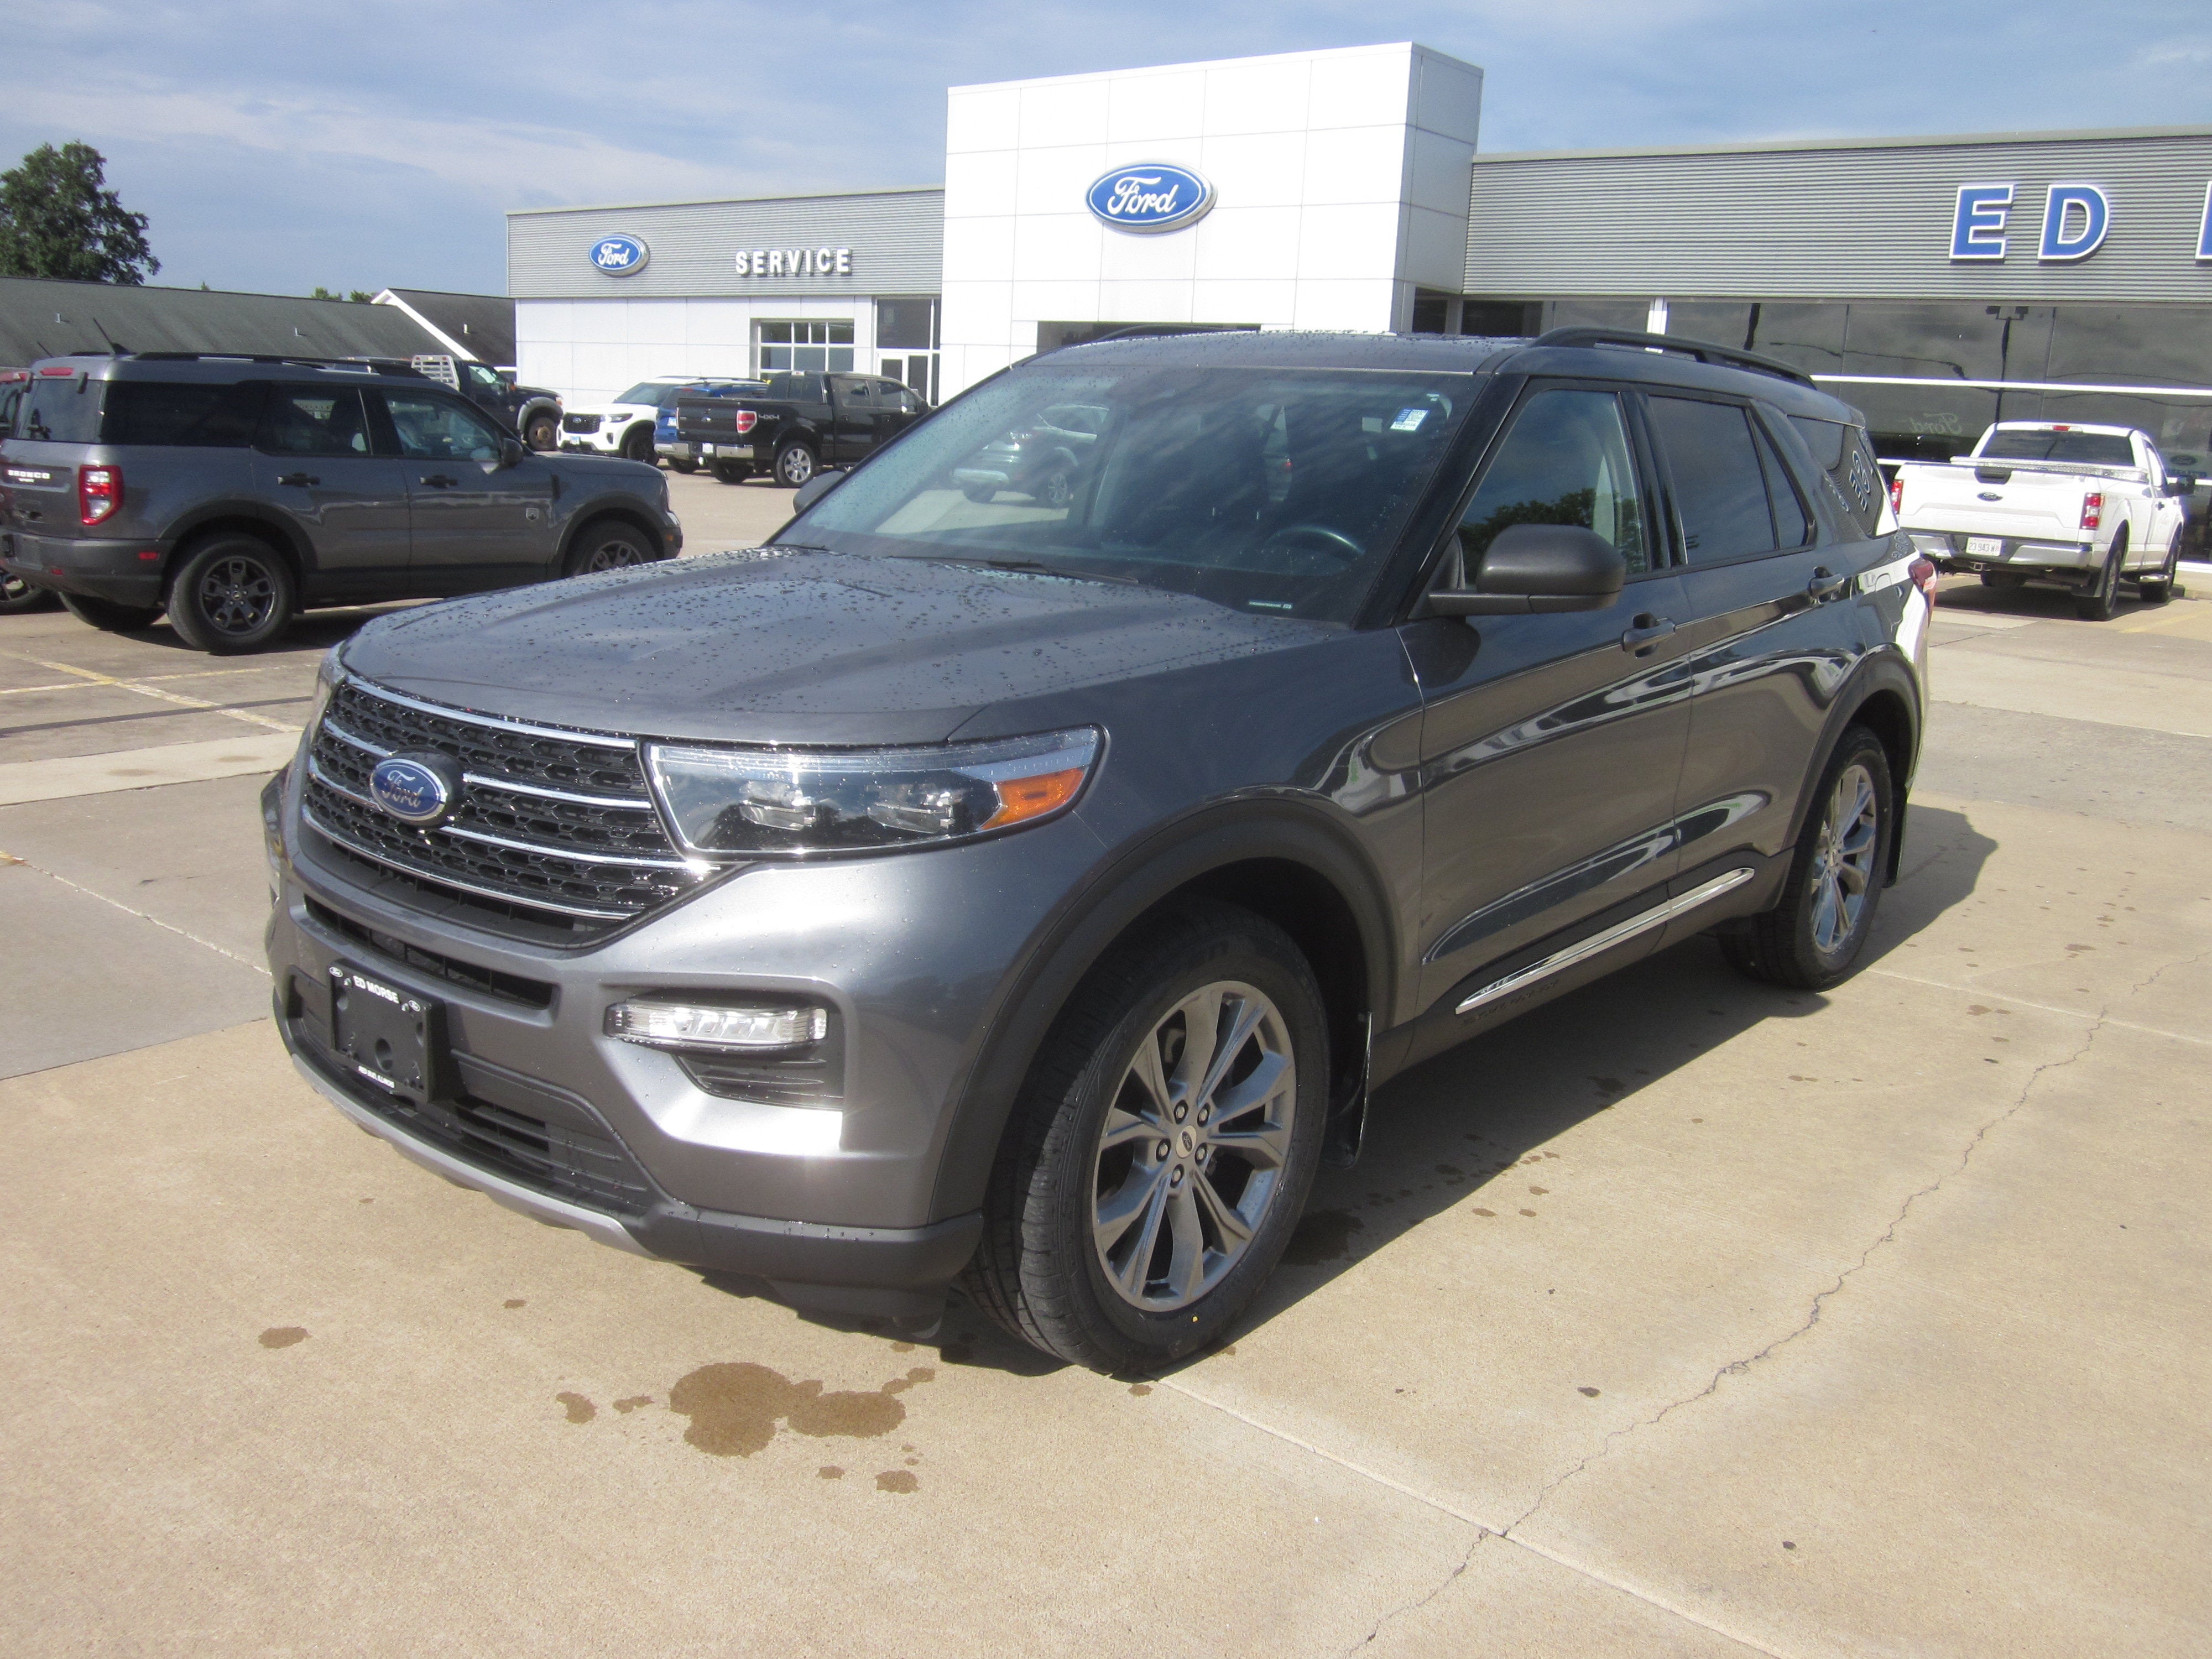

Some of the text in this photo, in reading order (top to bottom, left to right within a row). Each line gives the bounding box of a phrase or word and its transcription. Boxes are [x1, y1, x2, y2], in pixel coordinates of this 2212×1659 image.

[1107, 176, 1179, 215] Ford
[1948, 184, 2110, 260] ED
[598, 243, 630, 265] Ford
[735, 248, 851, 275] SERVICE
[8, 469, 51, 479] BRONCO
[381, 770, 424, 808] Ford
[353, 975, 400, 1004] ED MORSE
